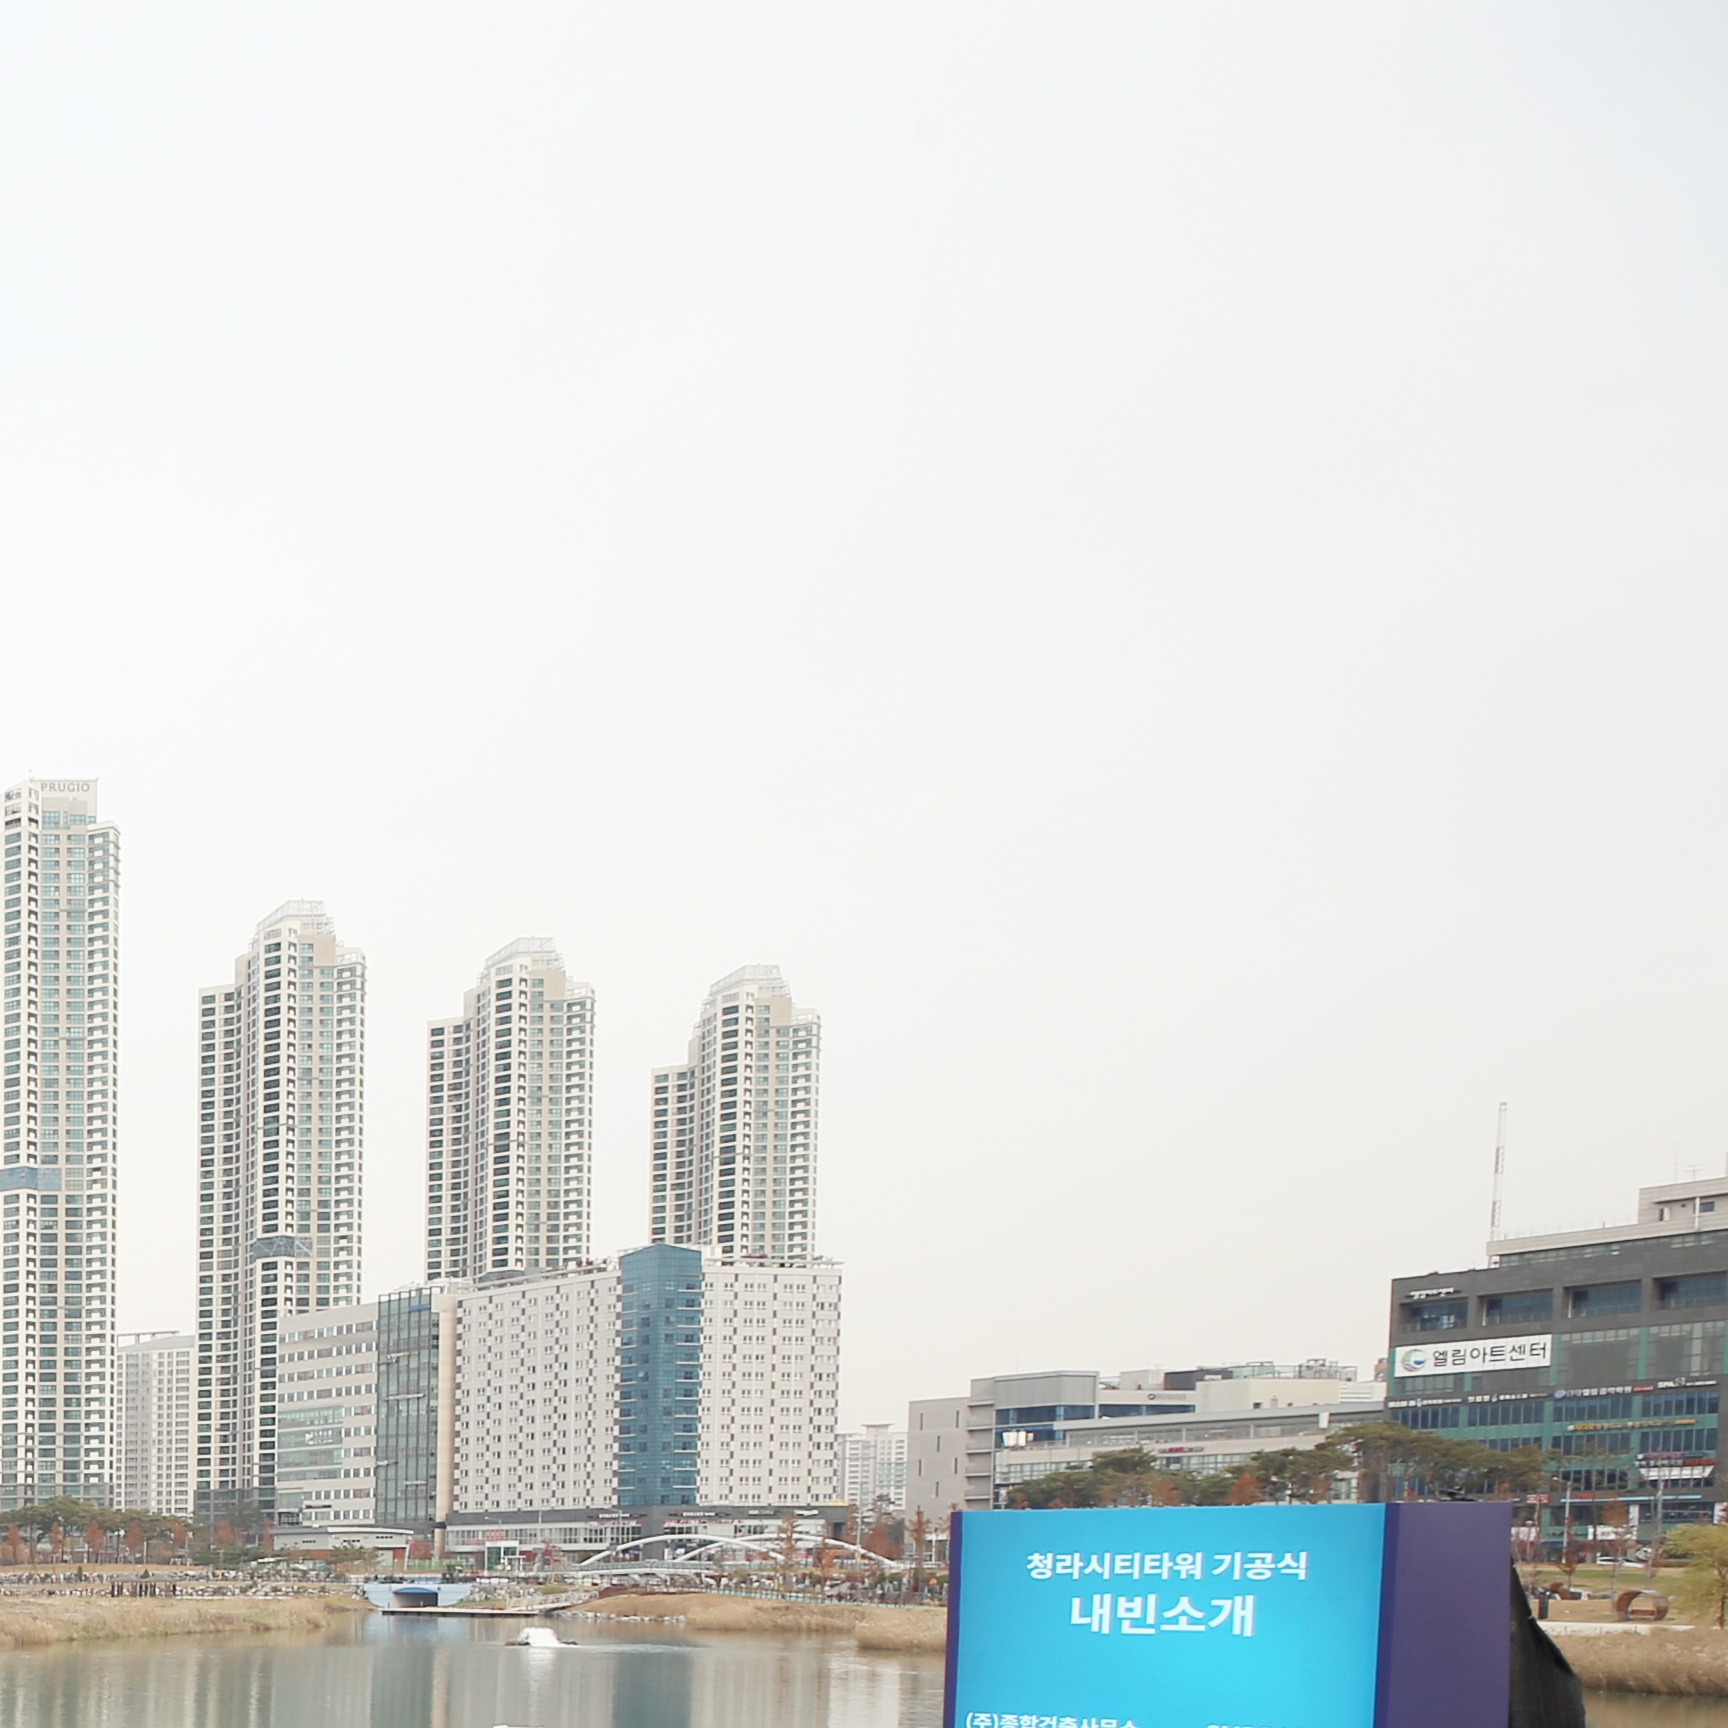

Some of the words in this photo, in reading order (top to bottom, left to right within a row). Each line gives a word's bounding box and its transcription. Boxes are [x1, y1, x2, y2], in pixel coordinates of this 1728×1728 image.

[41, 782, 90, 793] PRUGIO
[1433, 1341, 1547, 1367] 엘림아트센터
[1026, 1552, 1204, 1580] 청라시티타워
[1212, 1551, 1309, 1580] 기공식
[1070, 1593, 1257, 1637] 내빈소개
